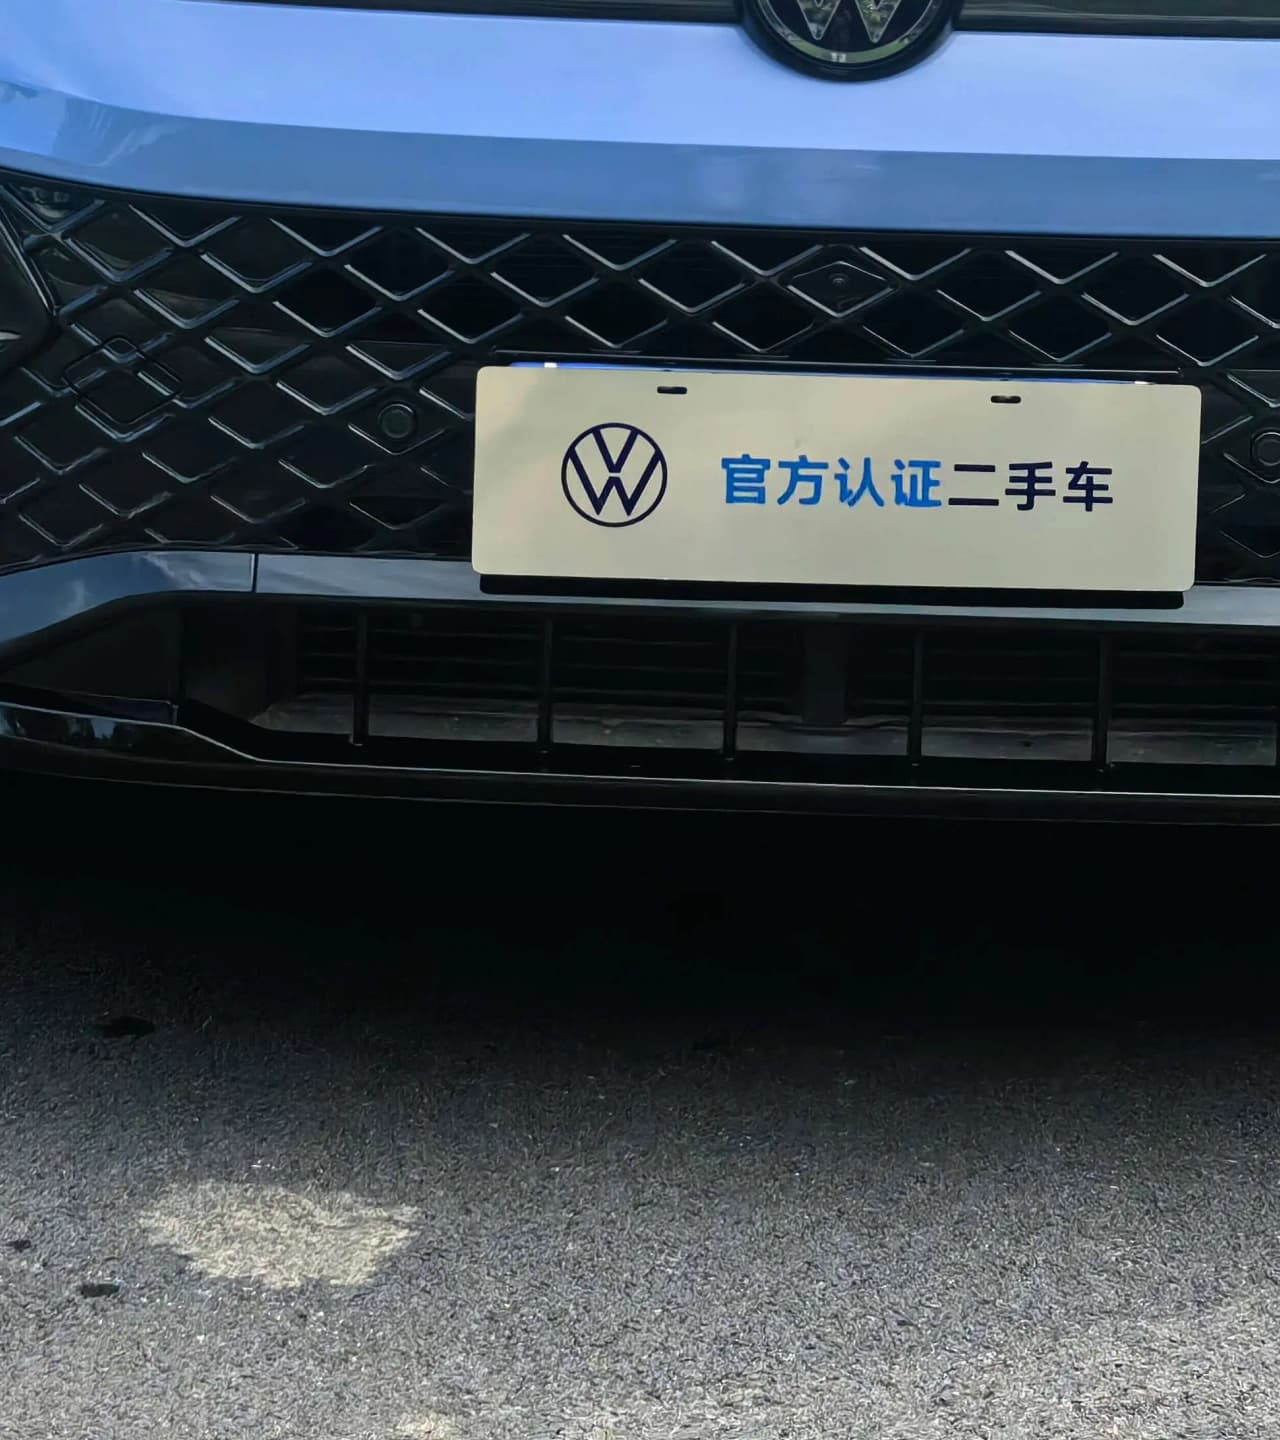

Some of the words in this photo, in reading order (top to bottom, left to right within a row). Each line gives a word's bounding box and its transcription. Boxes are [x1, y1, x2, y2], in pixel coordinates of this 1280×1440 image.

[721, 453, 1114, 513] 官方认证二手车
